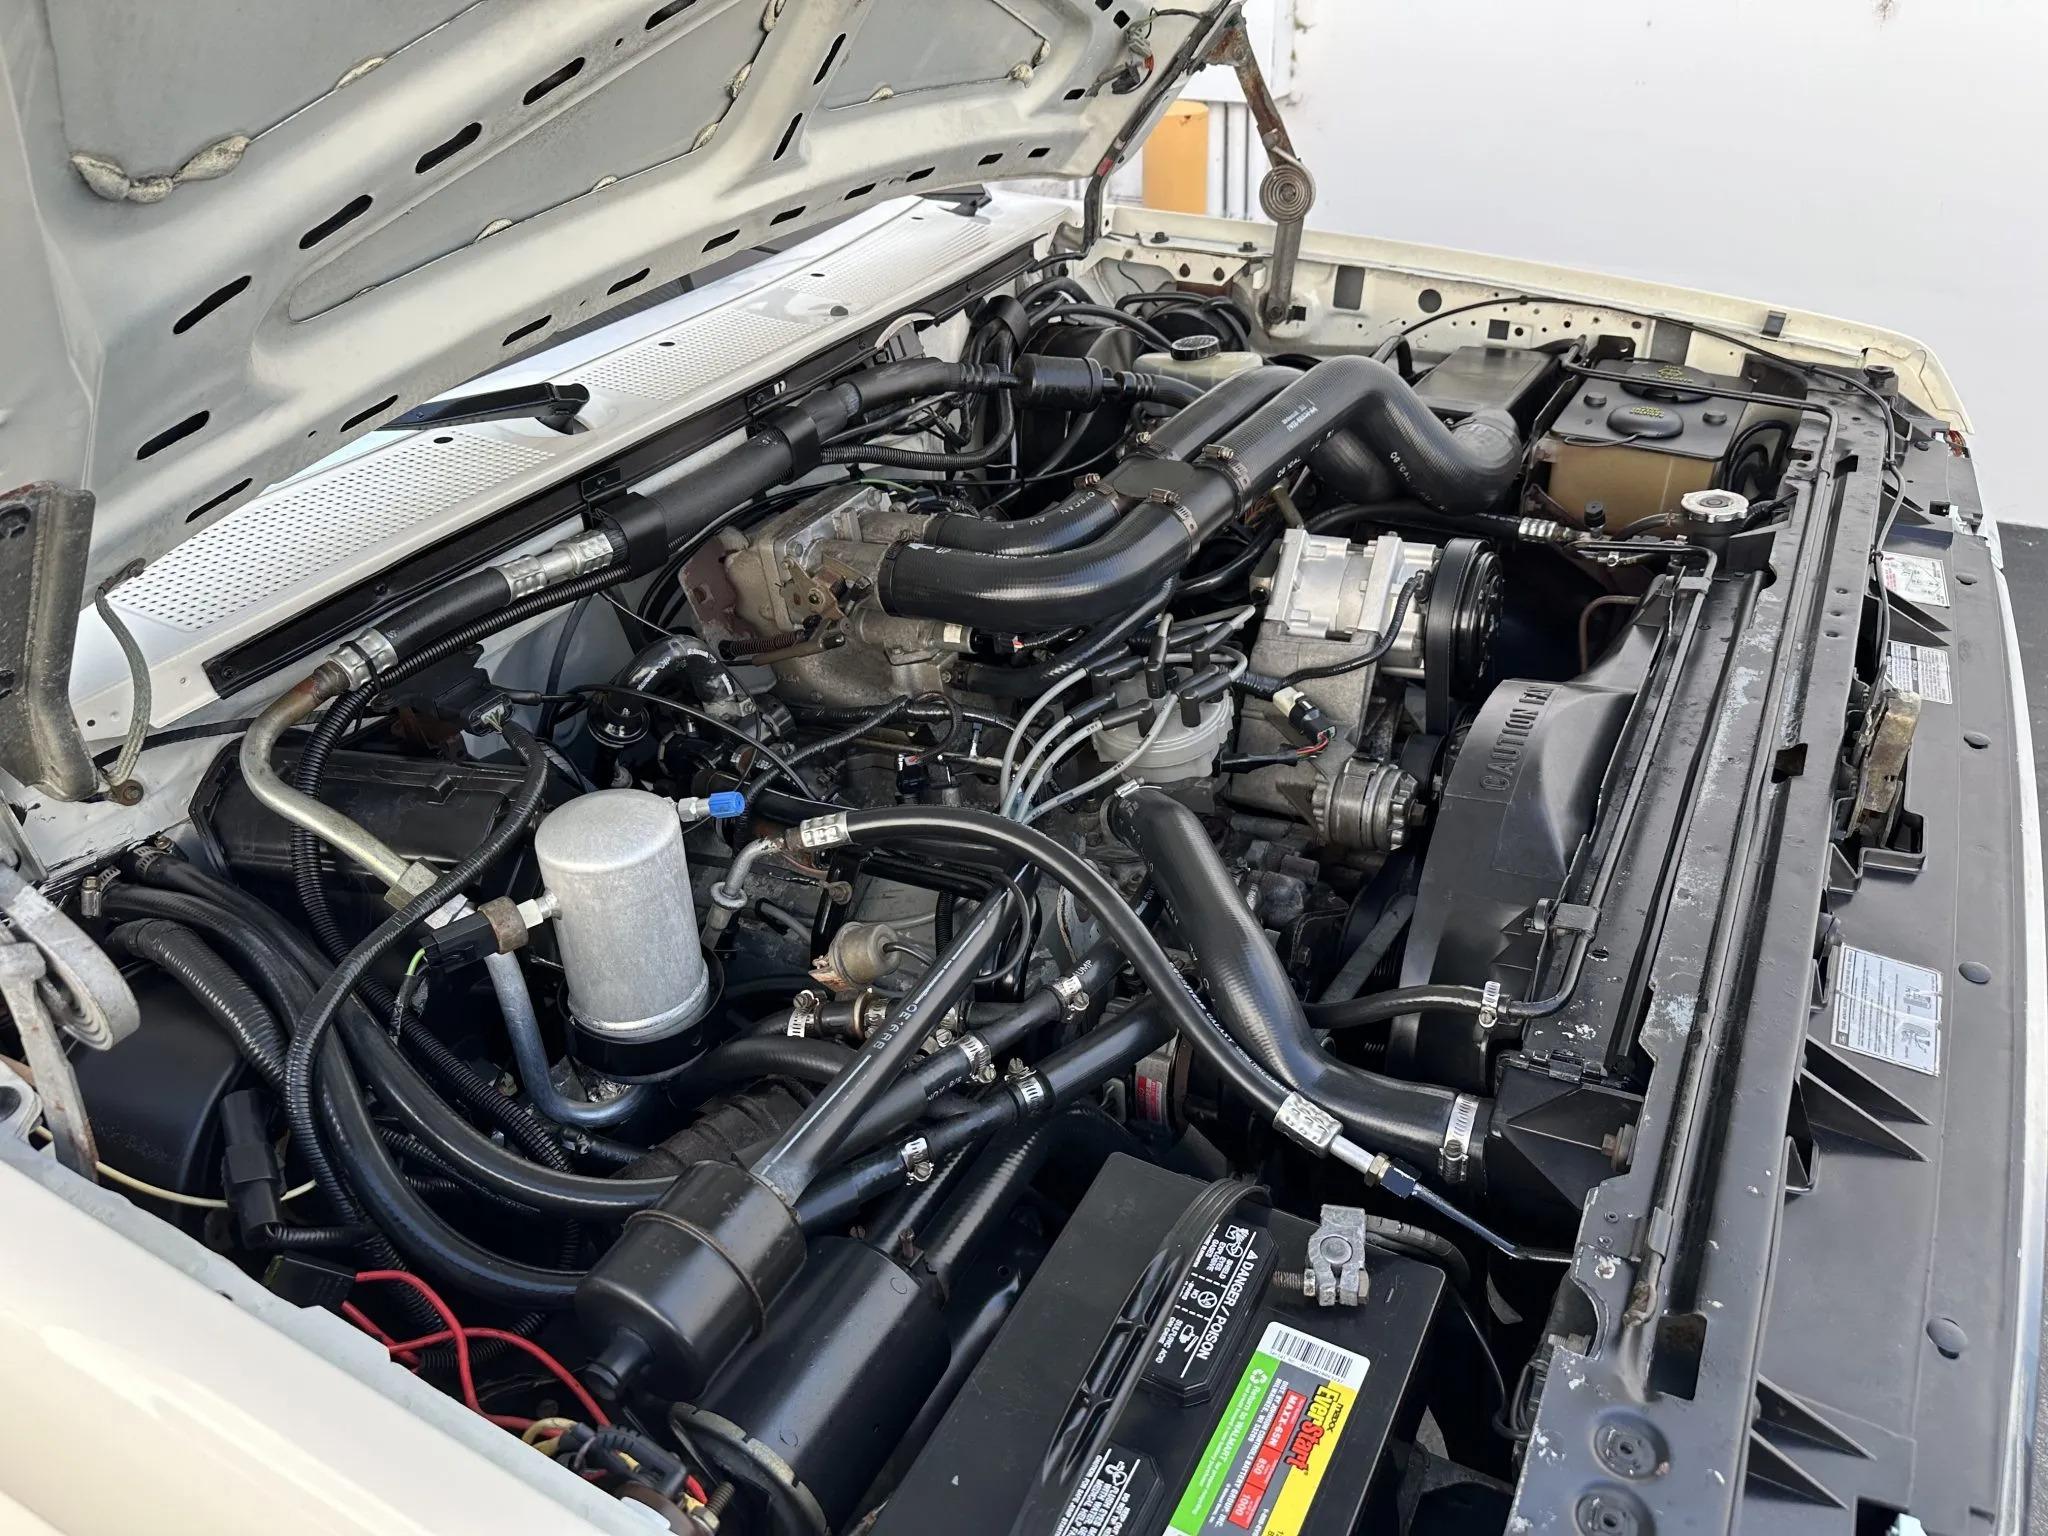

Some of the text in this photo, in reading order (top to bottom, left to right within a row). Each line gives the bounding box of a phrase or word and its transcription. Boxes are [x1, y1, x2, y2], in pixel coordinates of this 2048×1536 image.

[1479, 707, 1538, 791] CAUTION
[1204, 1237, 1219, 1258] GASES
[1189, 1287, 1200, 1299] NO
[1222, 1259, 1254, 1308] DANGER
[1154, 1318, 1183, 1364] SULFURIC ACID
[1195, 1314, 1227, 1361] POISON
[1242, 1384, 1260, 1412] Return
[1268, 1394, 1298, 1448] MAXX-65N
[1285, 1384, 1341, 1470] EverStart
[1327, 1402, 1344, 1433] maxx
[1218, 1419, 1244, 1463] WALMART
[1232, 1459, 1251, 1489] BATTERY
[1253, 1458, 1268, 1475] 850
[1083, 1479, 1104, 1507] MEDICAL
[1096, 1482, 1112, 1501] WITH
[1102, 1485, 1119, 1509] FLUSH
[1234, 1494, 1251, 1516] 1000
[1075, 1507, 1088, 1527] HELP
[1092, 1507, 1108, 1527] EYES
